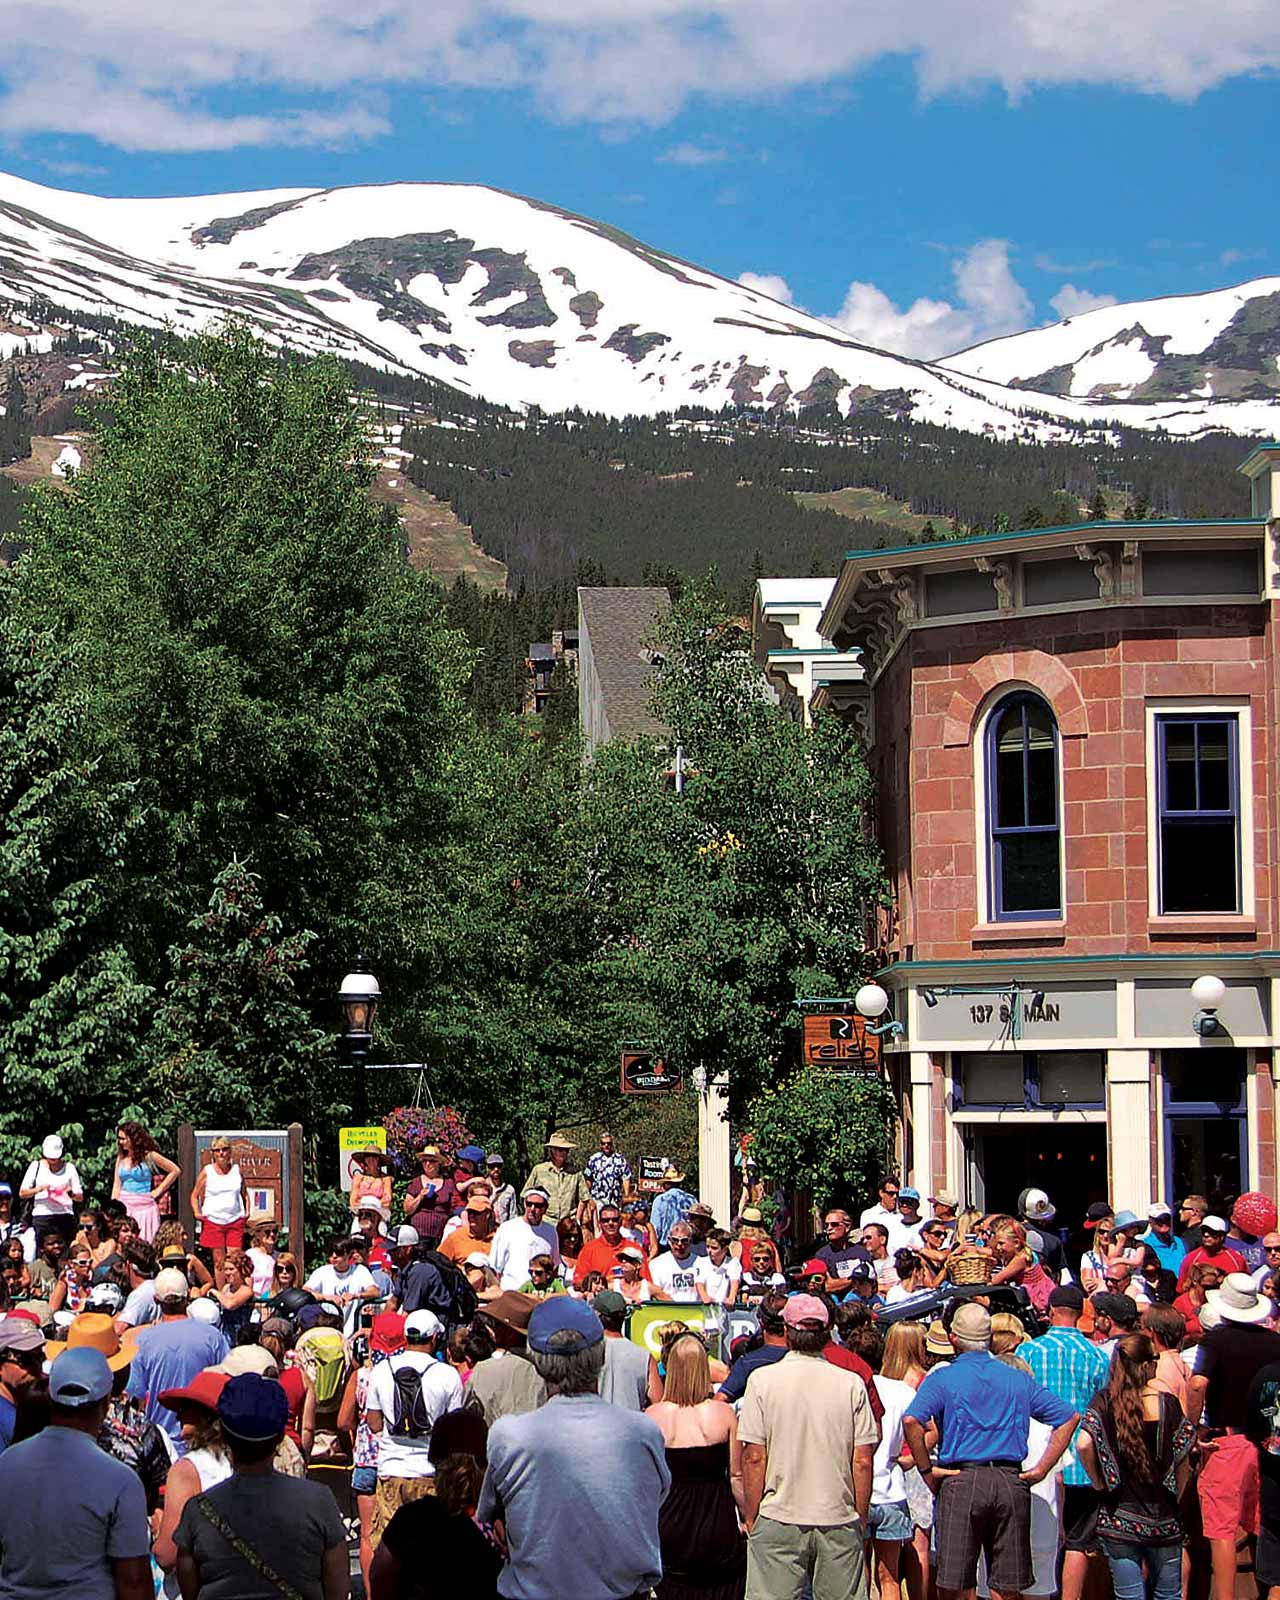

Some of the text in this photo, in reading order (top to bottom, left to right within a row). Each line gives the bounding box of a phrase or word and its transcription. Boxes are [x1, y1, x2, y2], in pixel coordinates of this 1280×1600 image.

[970, 1005, 994, 1023] 137
[1024, 1004, 1059, 1022] MAIN
[810, 1040, 876, 1060] relish
